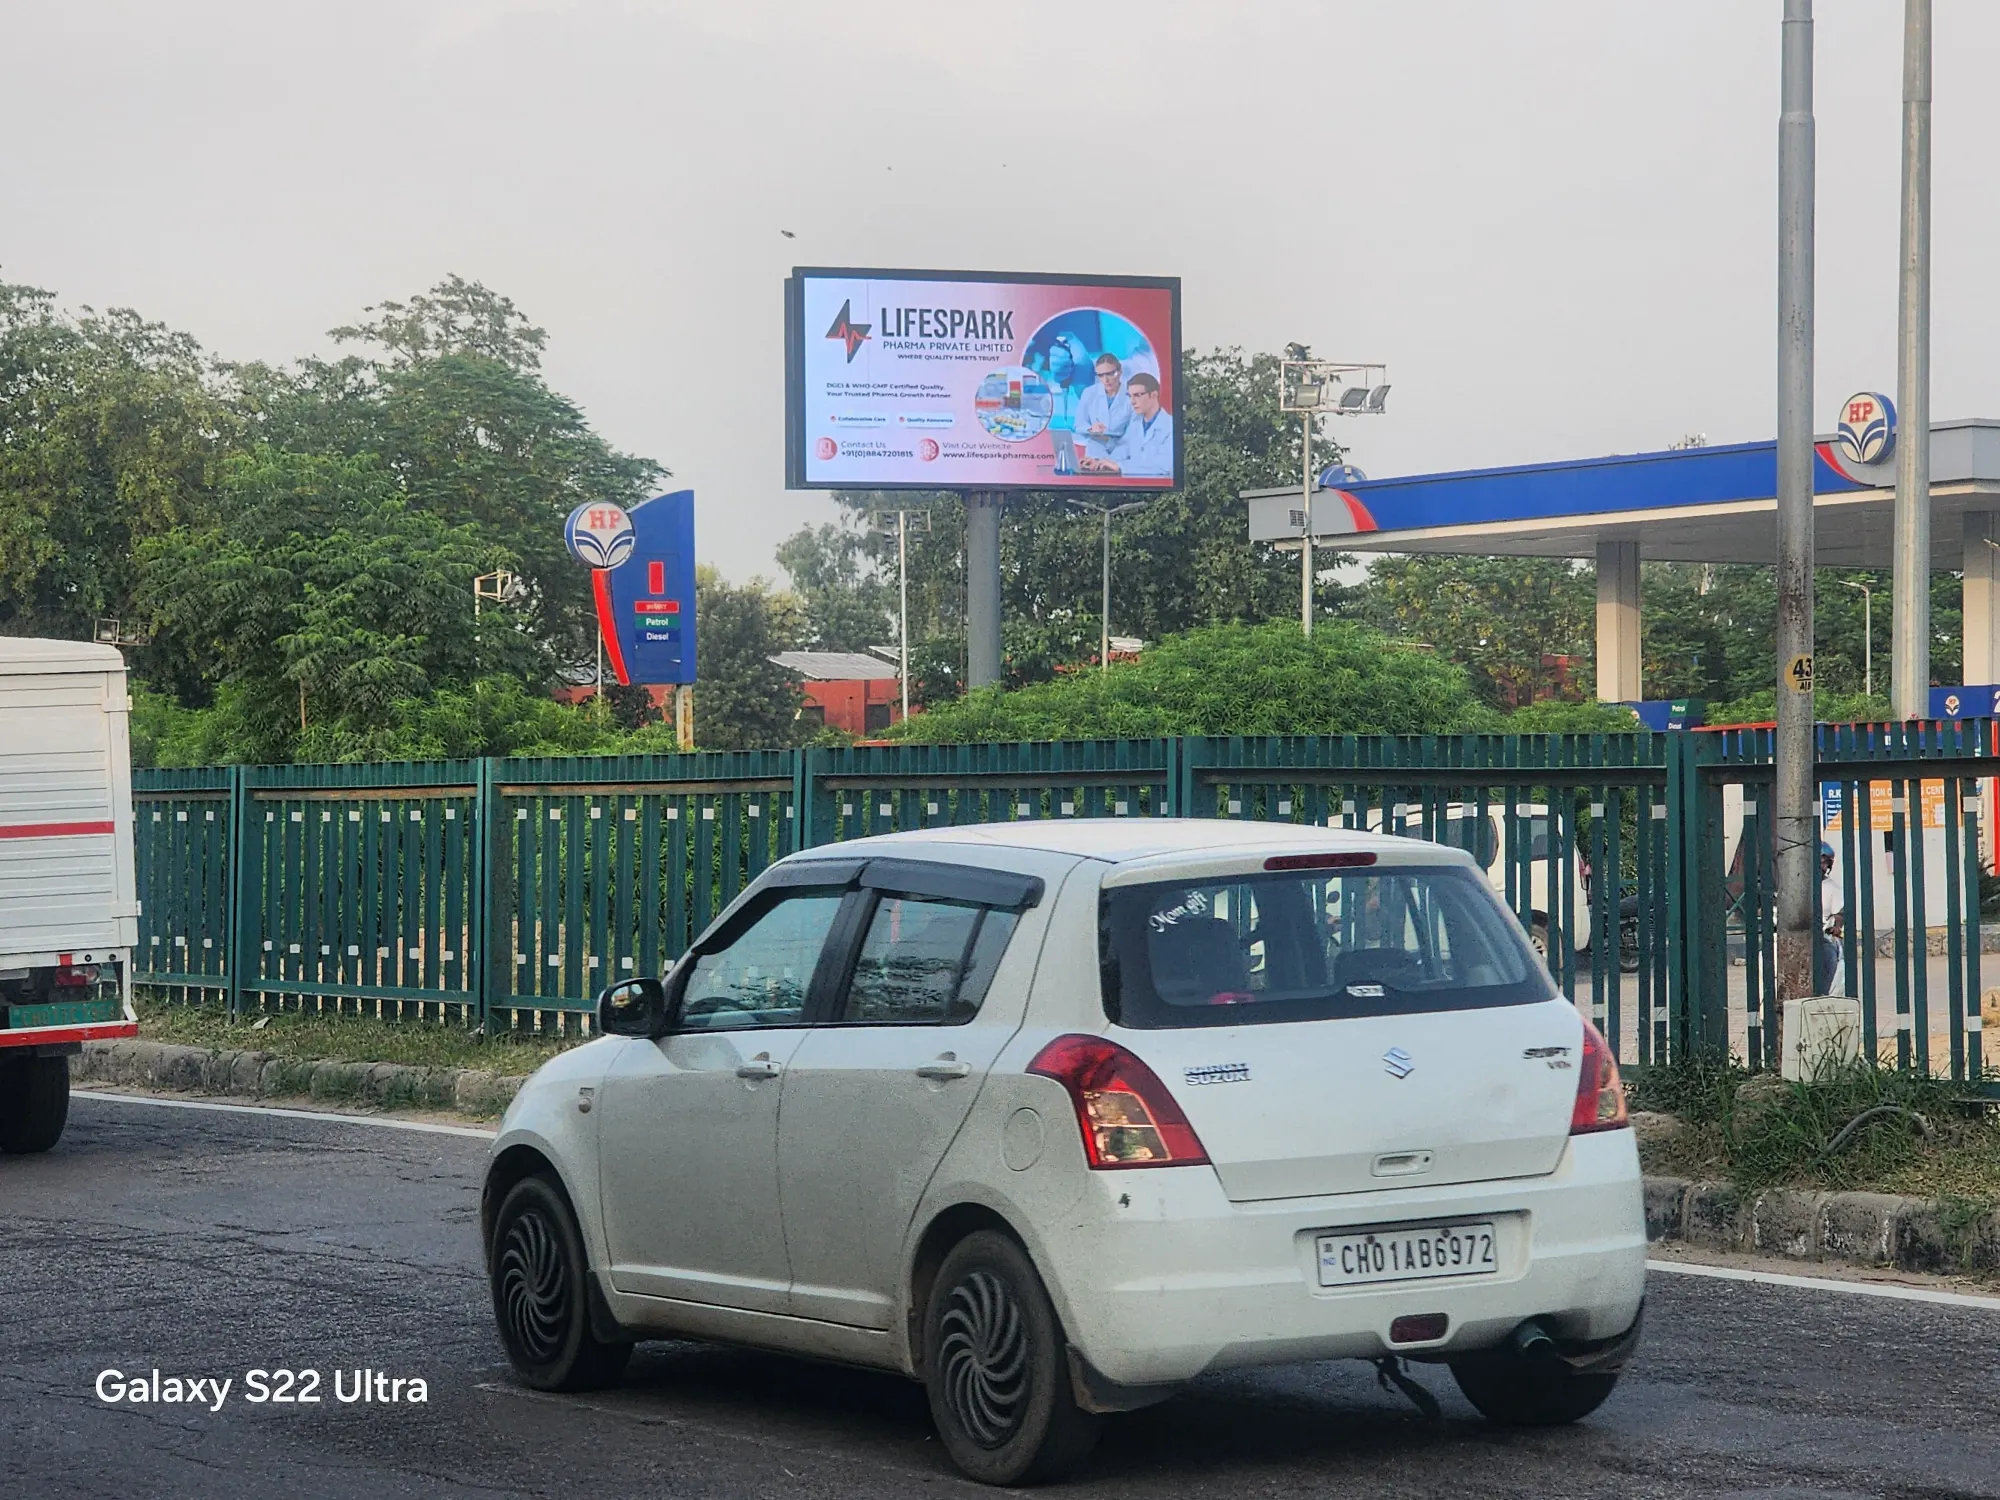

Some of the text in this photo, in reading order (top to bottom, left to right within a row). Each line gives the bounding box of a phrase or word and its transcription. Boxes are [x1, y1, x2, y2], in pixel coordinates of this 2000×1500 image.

[881, 307, 1014, 340] LIFESPARK
[883, 341, 1014, 353] PHARMA PRIVATE LIMITED
[1849, 402, 1874, 423] HP
[841, 441, 887, 449] Contact Us
[942, 451, 1055, 460] www.lifesparkpharma.com
[589, 511, 622, 529] HP
[646, 618, 669, 626] Petrol
[646, 632, 669, 641] Diesel
[1793, 658, 1812, 678] 43
[1185, 1072, 1252, 1086] SUZUKI
[1341, 1234, 1493, 1274] CH01AB6972
